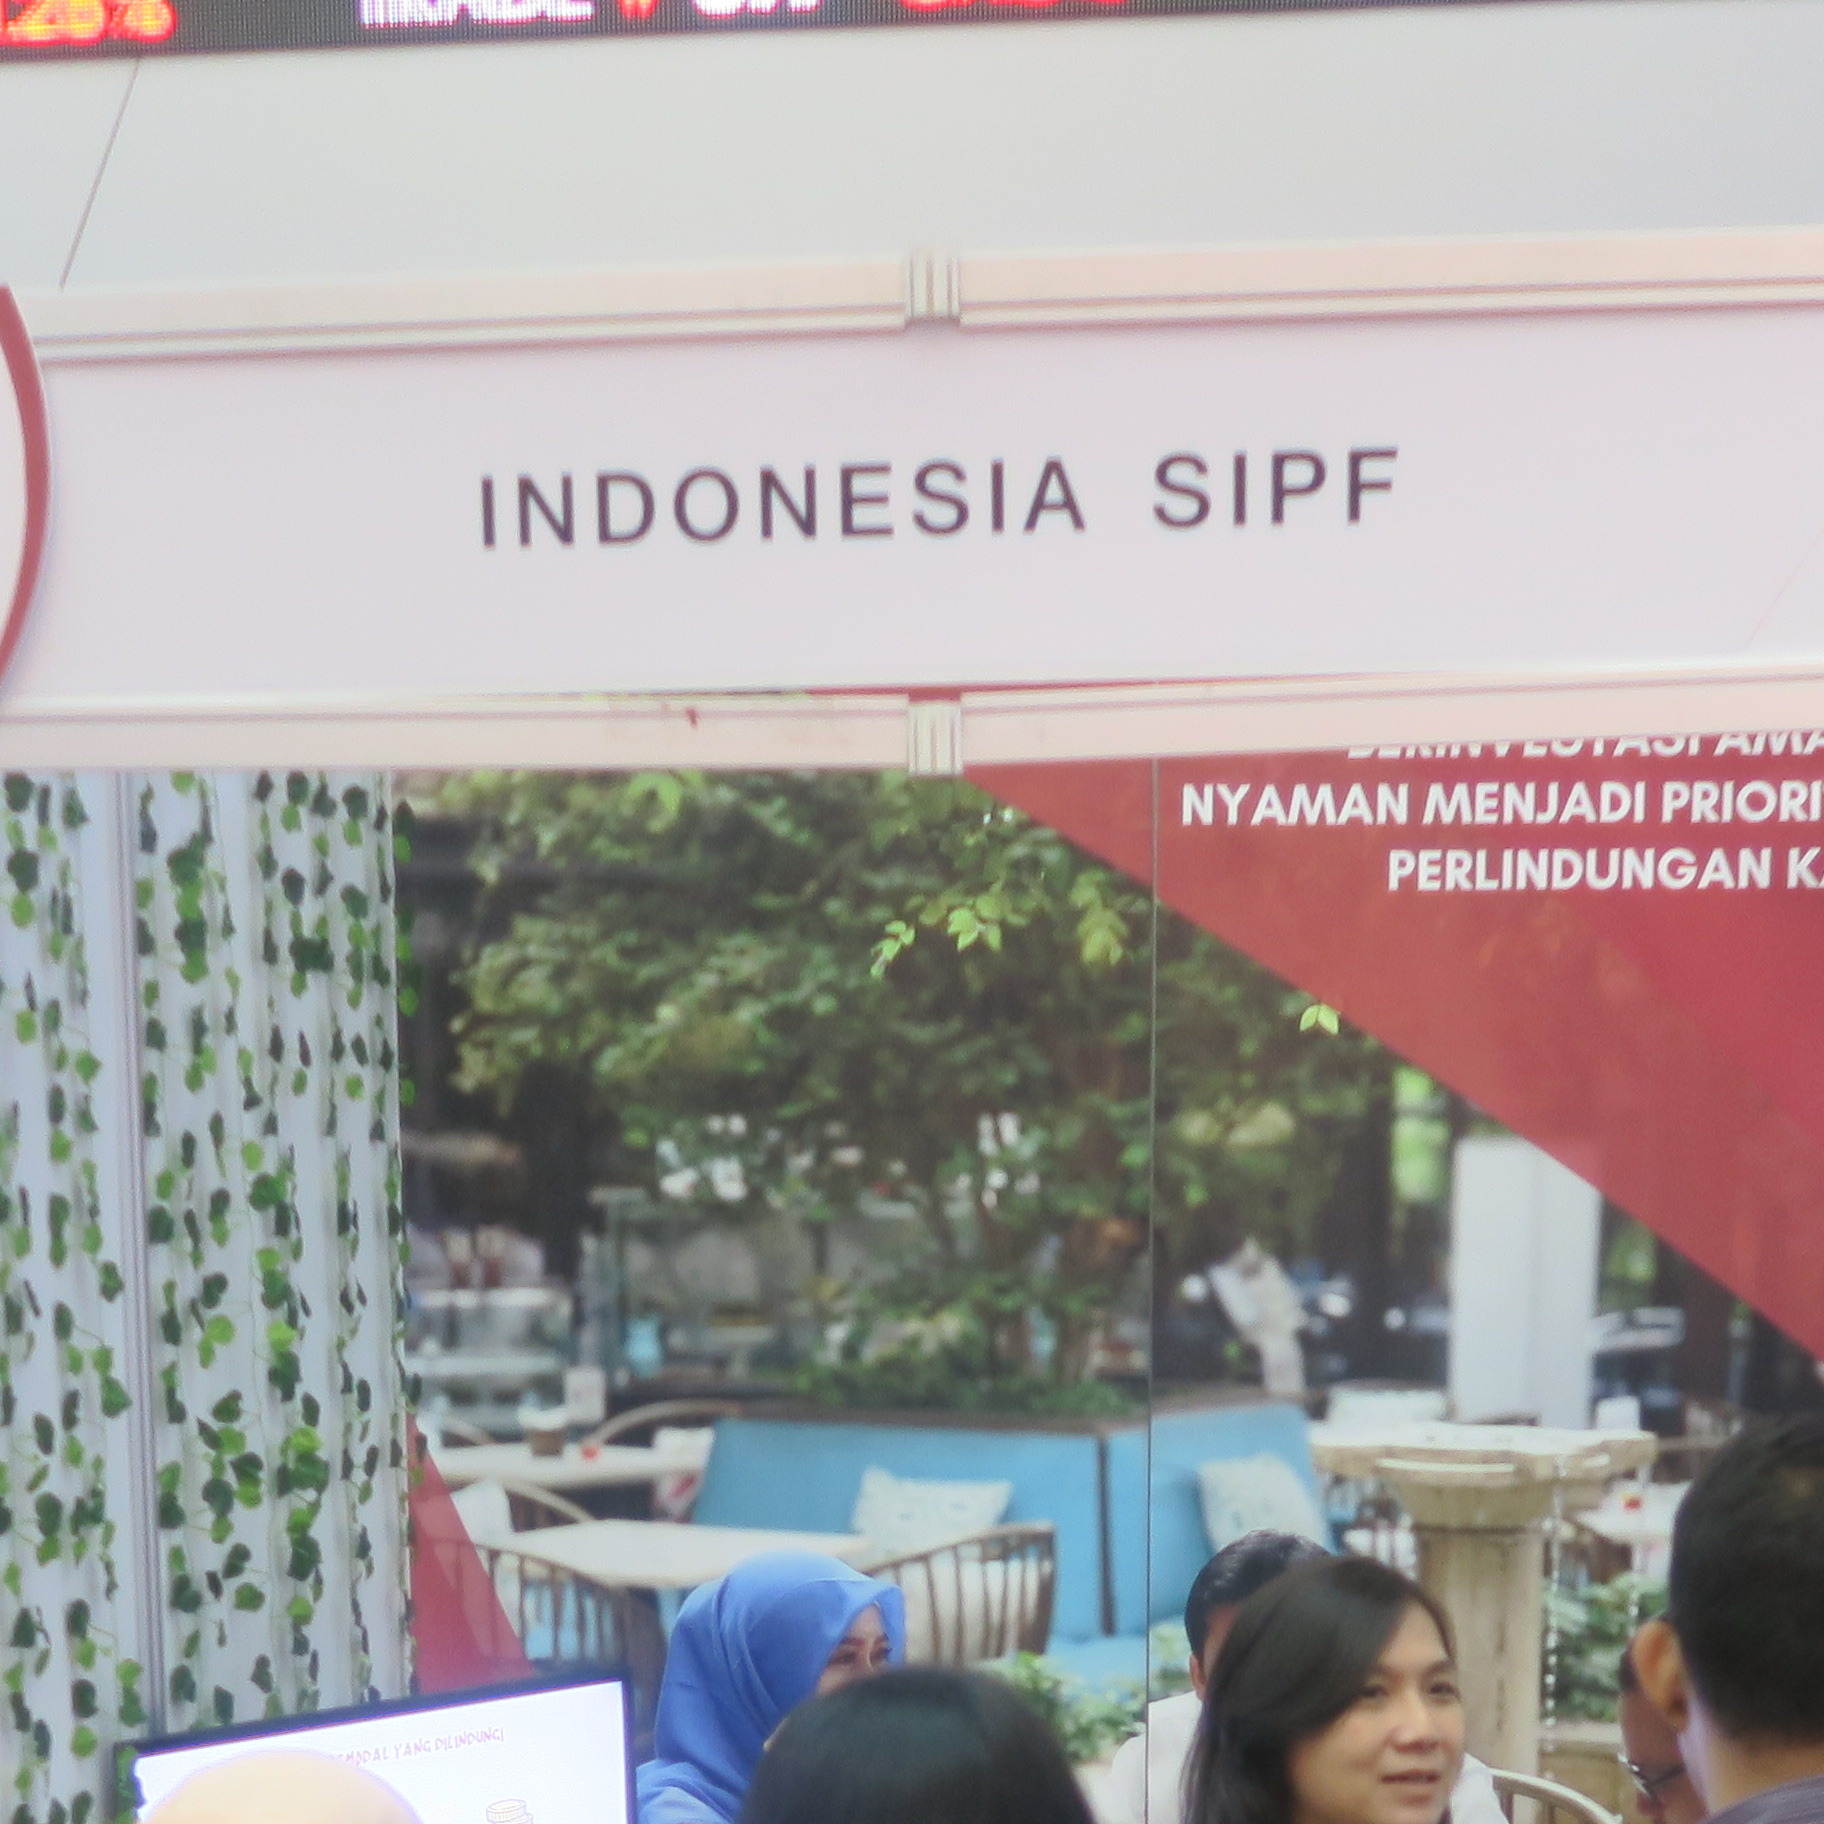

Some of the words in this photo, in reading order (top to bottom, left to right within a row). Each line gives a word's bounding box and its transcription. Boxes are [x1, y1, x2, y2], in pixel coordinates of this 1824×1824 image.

[480, 457, 1087, 549] INDONESIA
[1152, 448, 1399, 529] SIPF
[1181, 782, 1410, 826] NYAMAN
[1422, 780, 1646, 825] MENJADI
[1387, 847, 1772, 892] PERLINDUNGAN
[338, 1747, 390, 1766] MODAL
[394, 1738, 432, 1760] YANG
[434, 1727, 505, 1752] DILINDUNGI
